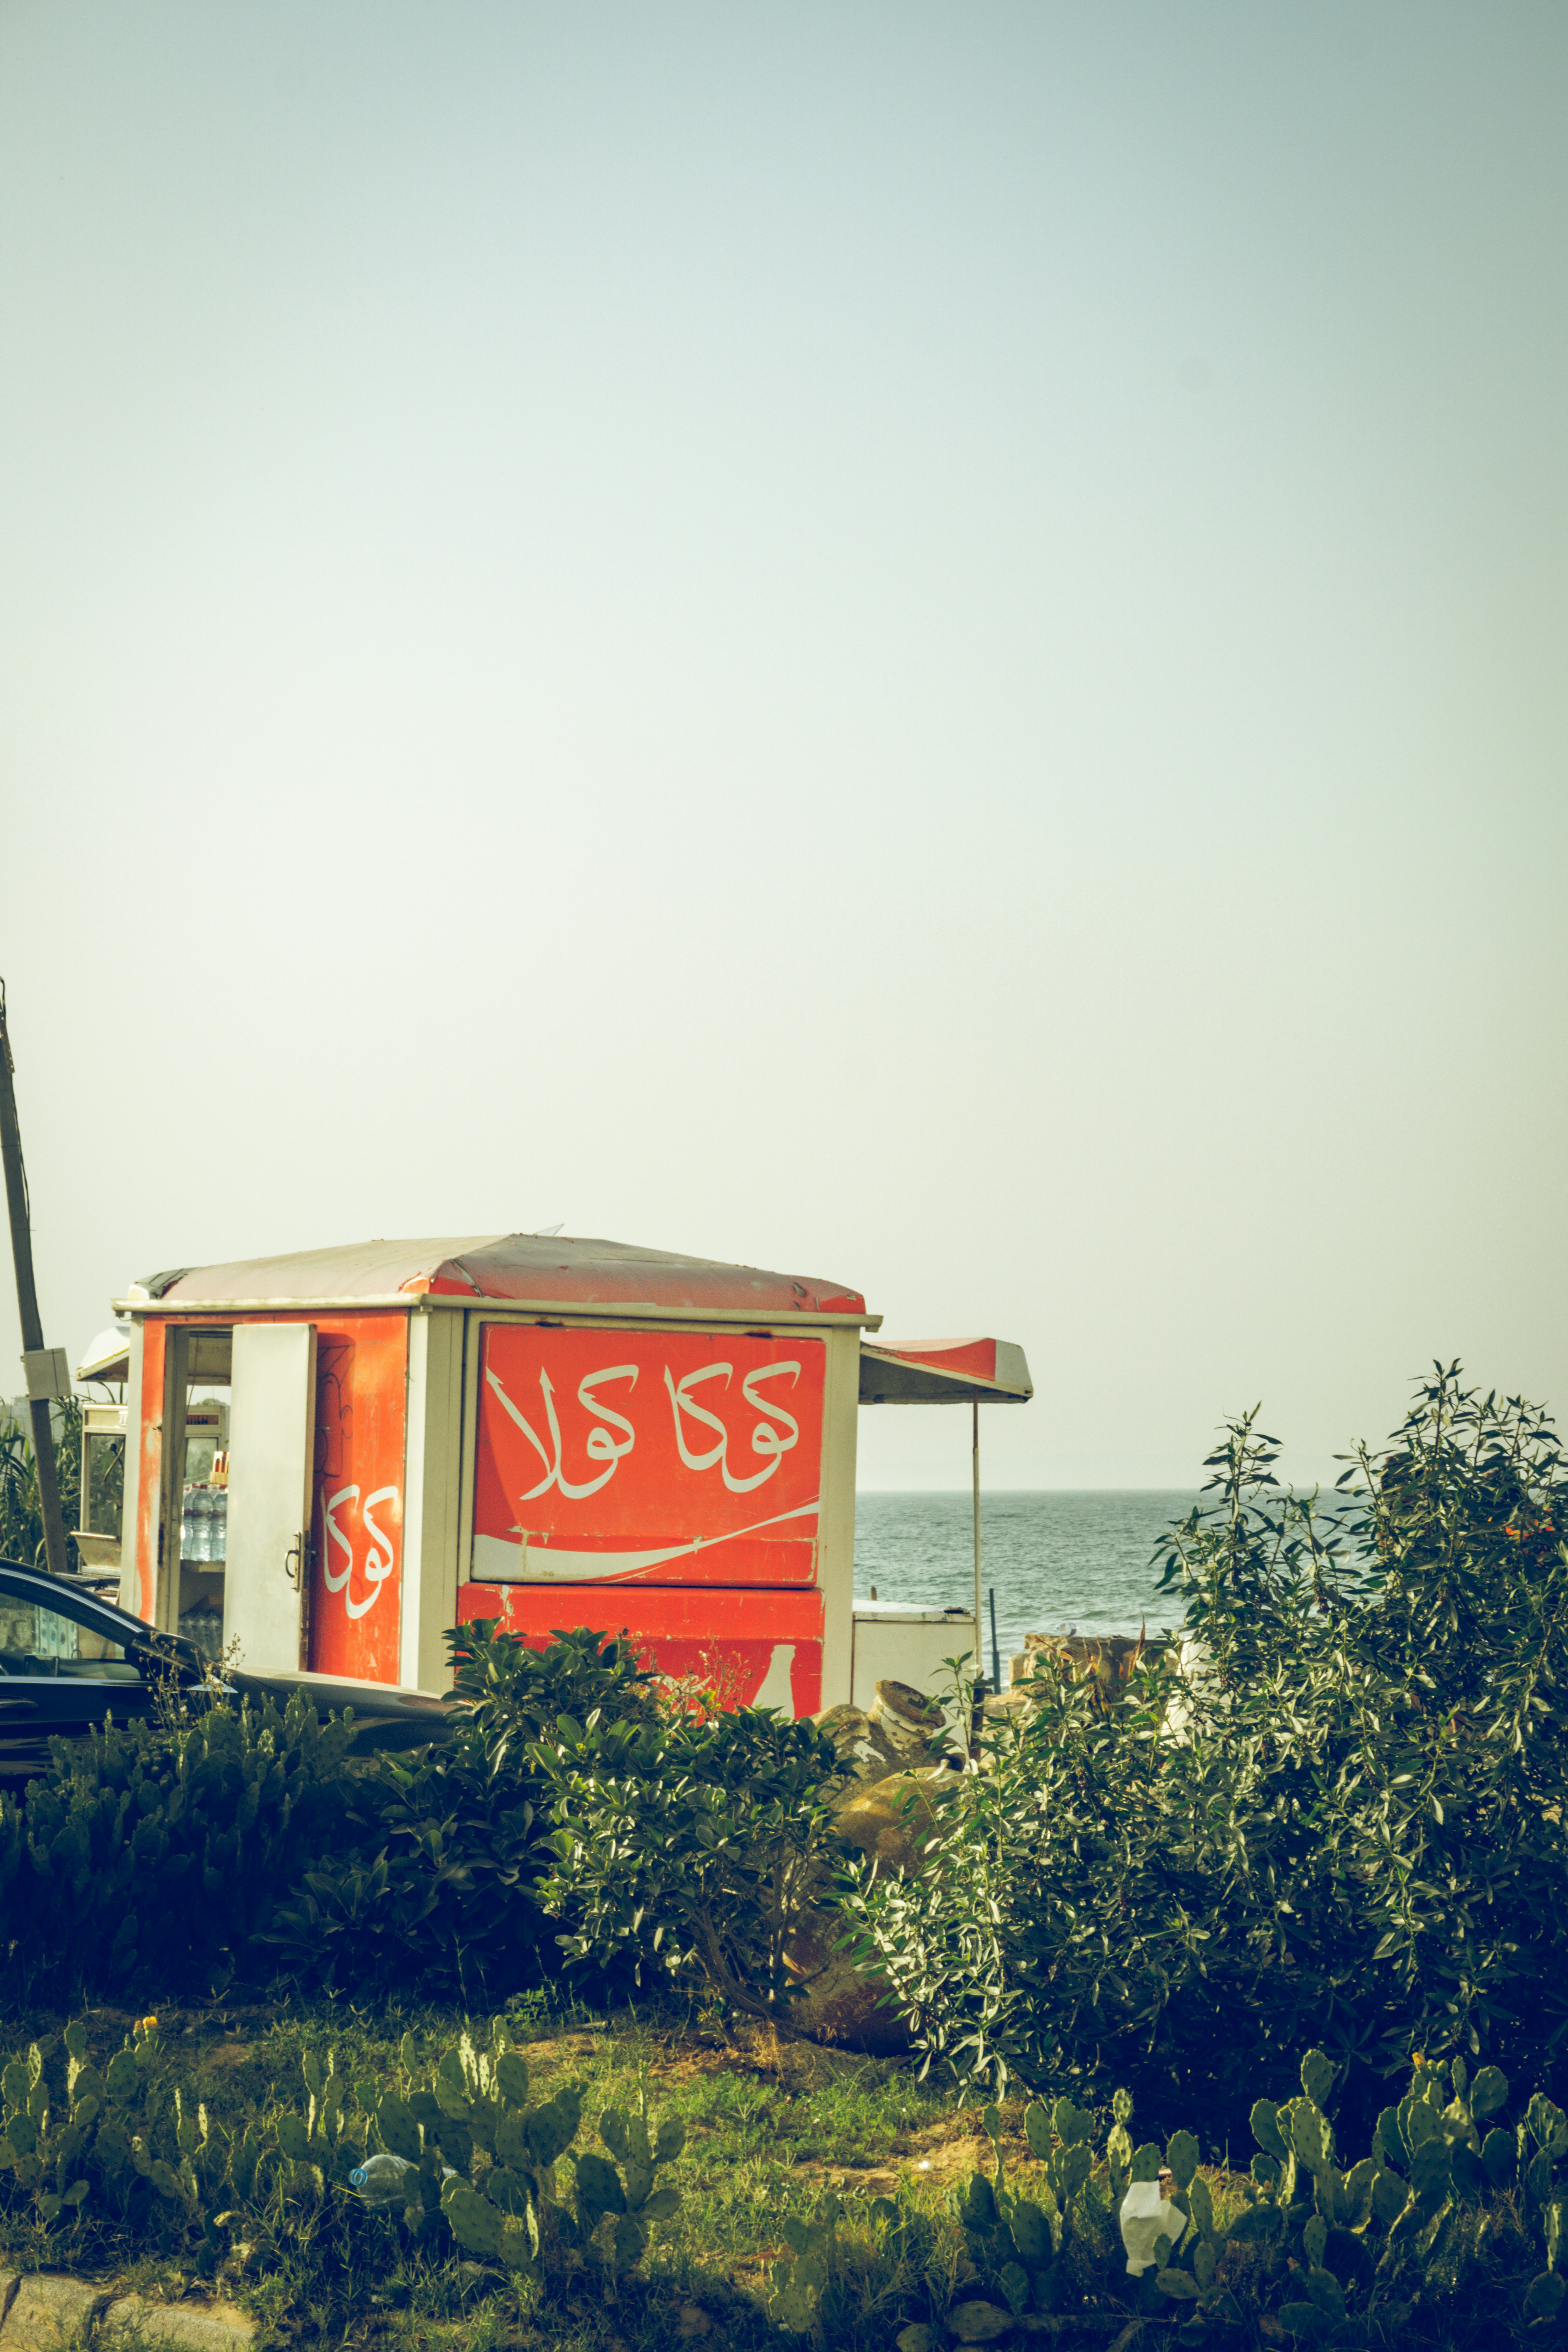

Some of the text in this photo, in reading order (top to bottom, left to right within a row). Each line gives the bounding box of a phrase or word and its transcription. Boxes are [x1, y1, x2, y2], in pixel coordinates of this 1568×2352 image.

[486, 1360, 802, 1500] كوكا كولا
[320, 1484, 399, 1619] كوكا
